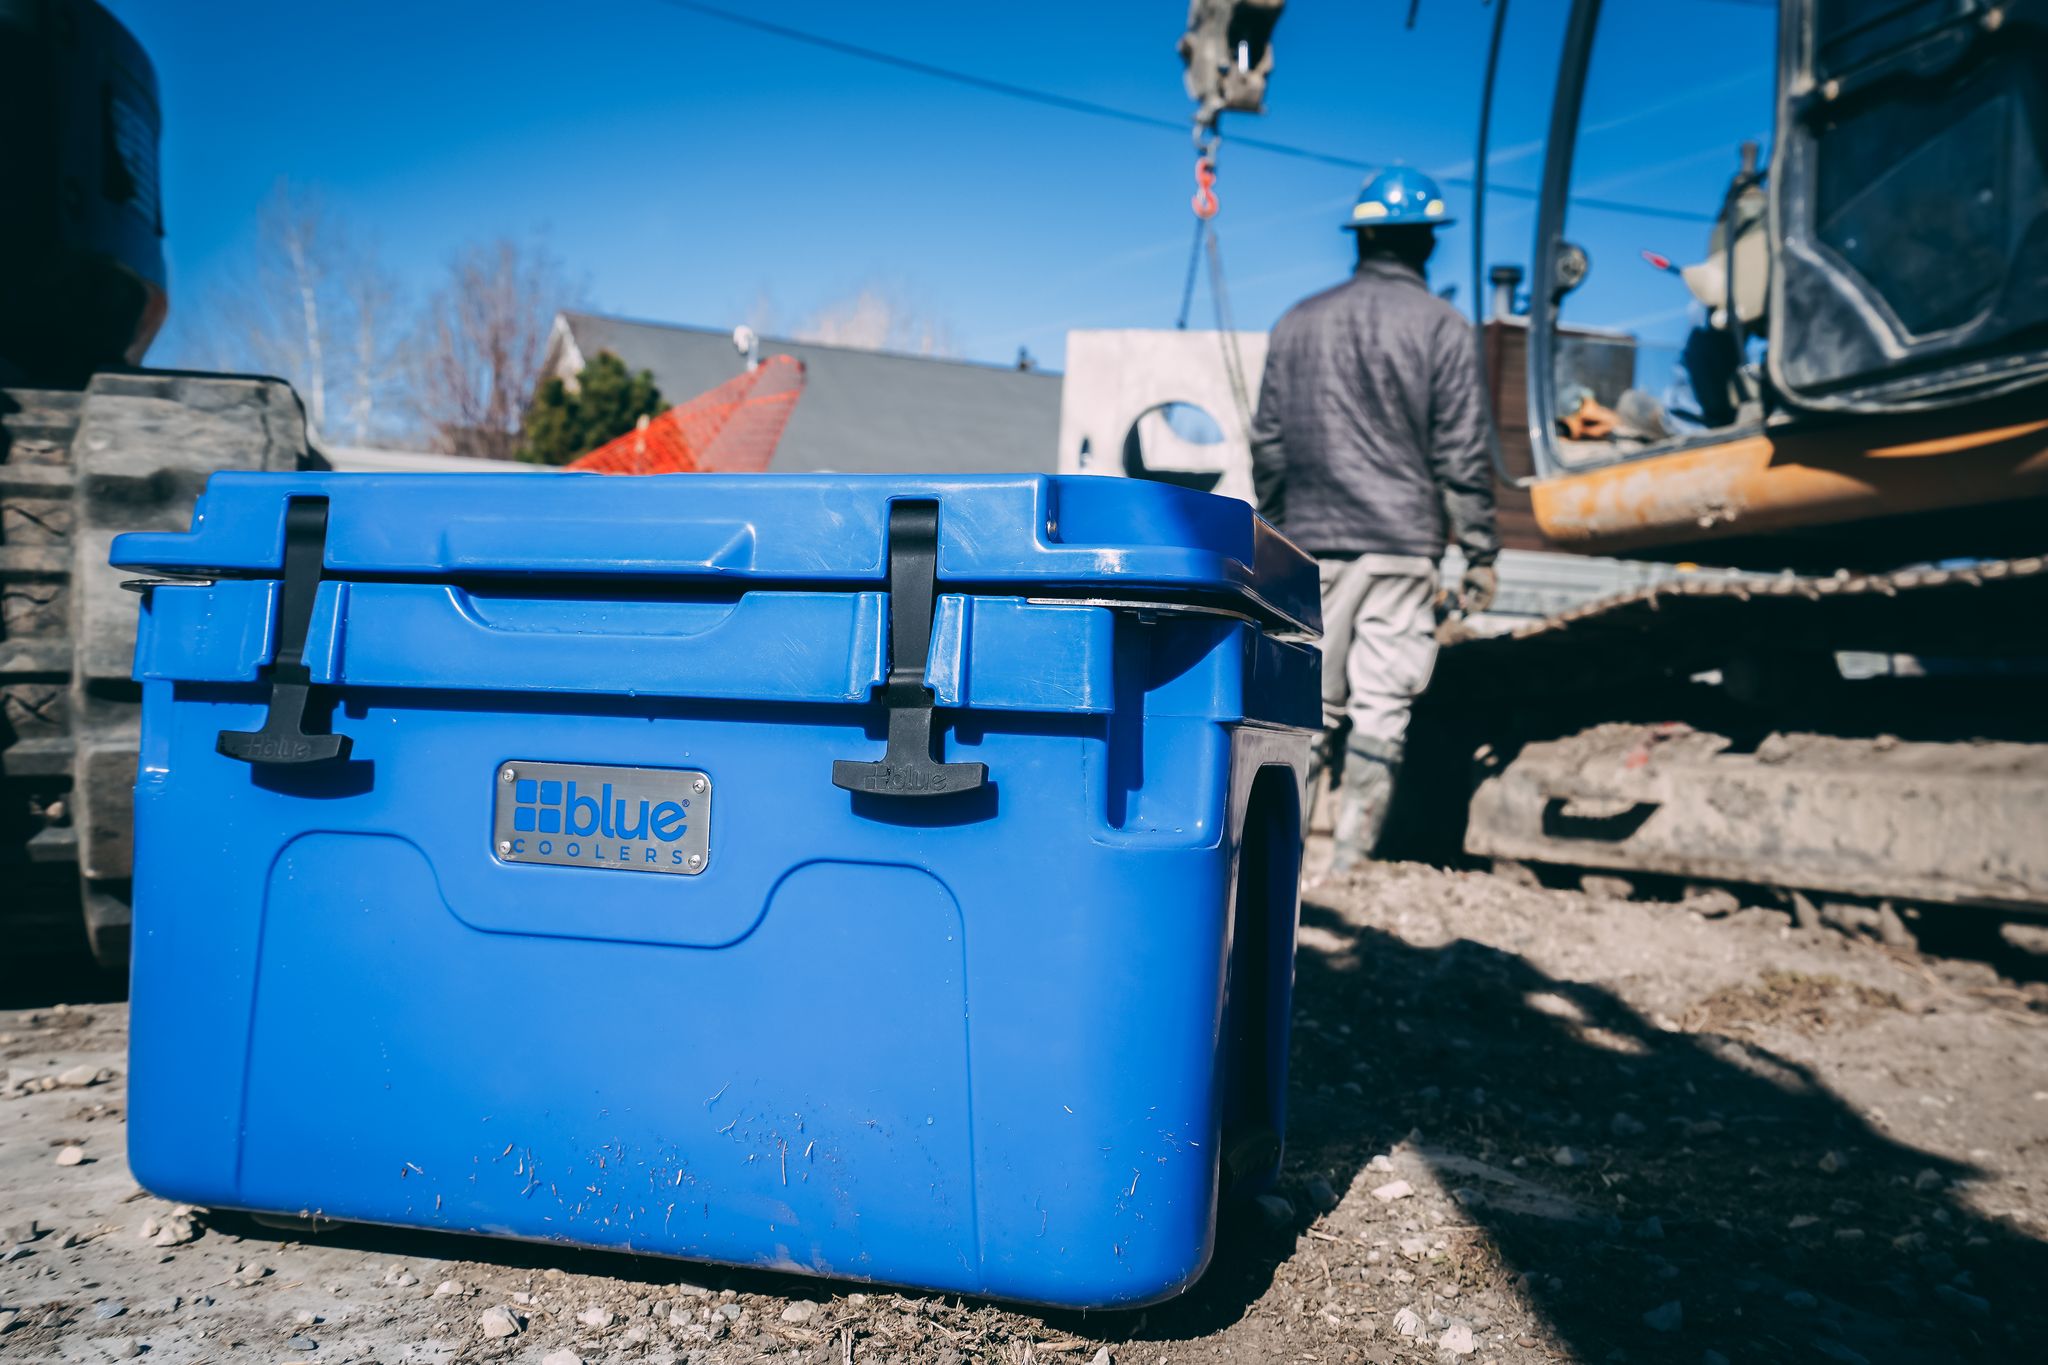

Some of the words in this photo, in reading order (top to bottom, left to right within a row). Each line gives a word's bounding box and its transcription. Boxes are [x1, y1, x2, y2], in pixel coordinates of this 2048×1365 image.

[888, 763, 948, 792] blue
[565, 781, 688, 842] blue
[513, 838, 683, 865] COOLERS
